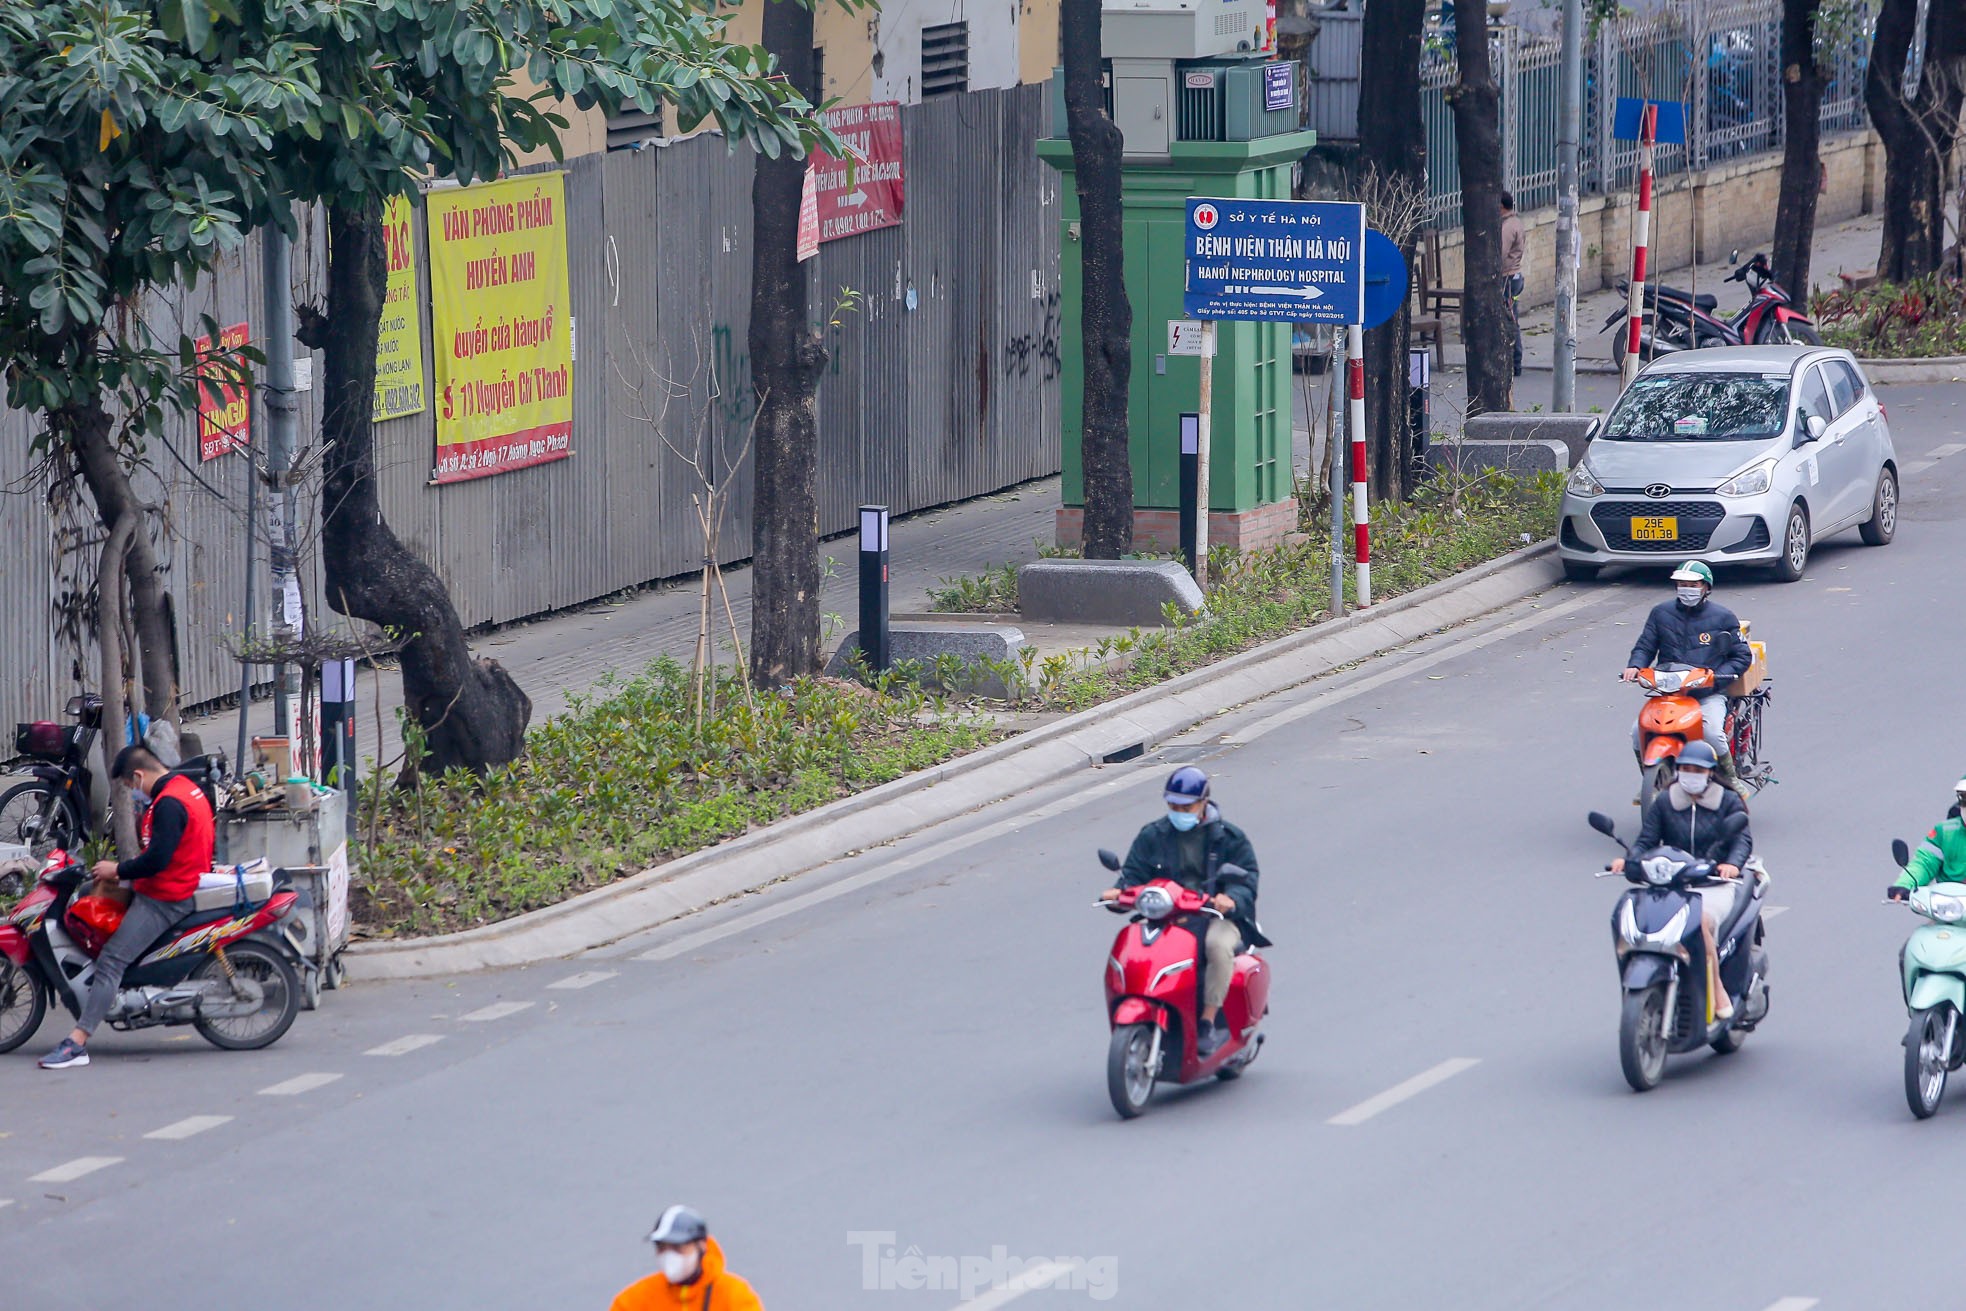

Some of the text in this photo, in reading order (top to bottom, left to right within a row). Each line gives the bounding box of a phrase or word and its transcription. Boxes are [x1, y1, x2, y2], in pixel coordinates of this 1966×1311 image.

[841, 107, 863, 126] PHOTO
[443, 187, 553, 241] VĂN PHÒNG PHẨM
[1229, 211, 1244, 222] SỞ
[1261, 212, 1276, 223] TẾ
[1281, 214, 1296, 224] HÀ
[1301, 214, 1321, 227] NỘI
[1196, 233, 1350, 264] BỆNH VIỆN THẬN HÀ NỘI
[466, 248, 535, 290] HUYỀN ANH
[1232, 267, 1295, 282] NEPHROLOGY
[1299, 270, 1346, 284] HOSPITAL
[1278, 302, 1292, 310] VIỆN
[491, 316, 510, 352] cửa
[514, 315, 538, 348] hàng
[476, 368, 516, 416] Nguyễn
[498, 446, 508, 463] 17
[546, 432, 568, 452] Phách
[1636, 530, 1672, 538] 001.38
[1644, 519, 1663, 528] 29E
